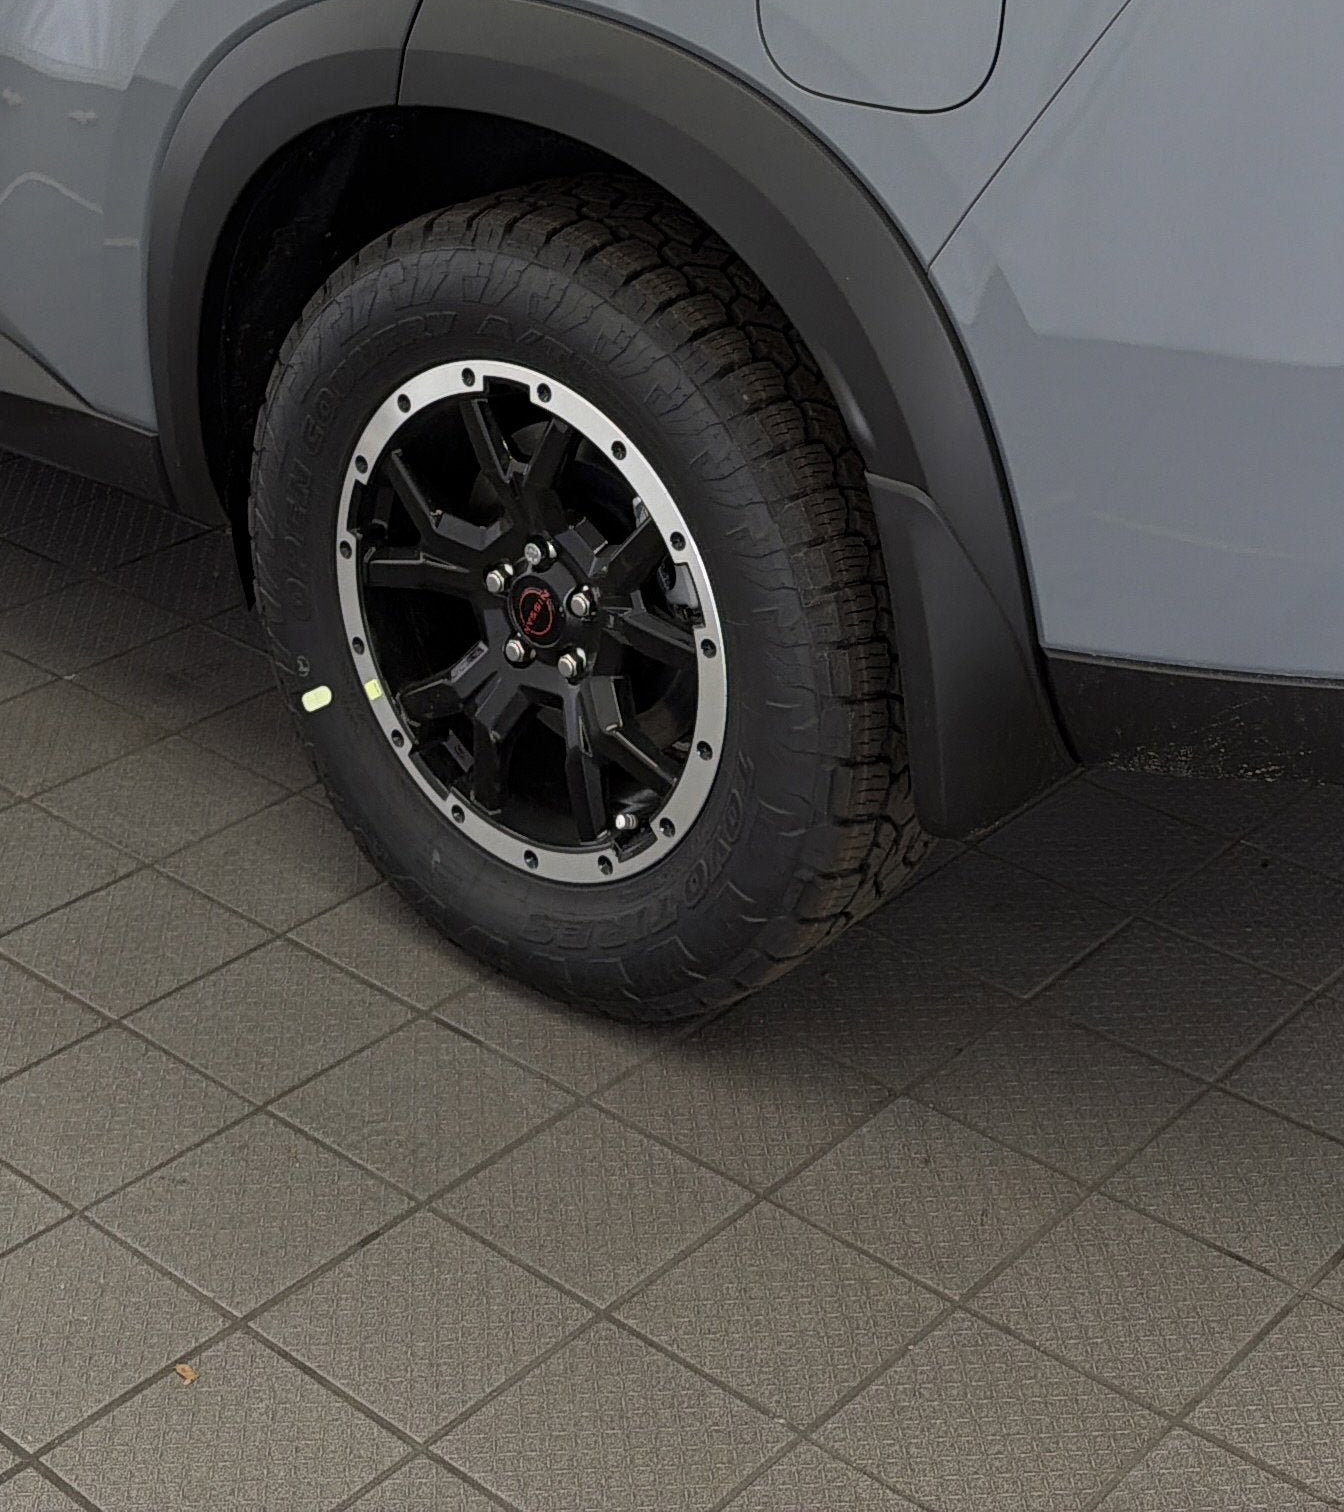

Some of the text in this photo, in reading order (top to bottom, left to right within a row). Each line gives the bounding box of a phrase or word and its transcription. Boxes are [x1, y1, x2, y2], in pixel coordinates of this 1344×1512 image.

[523, 588, 552, 635] NISSAN
[517, 749, 755, 952] TOYO TIRES
